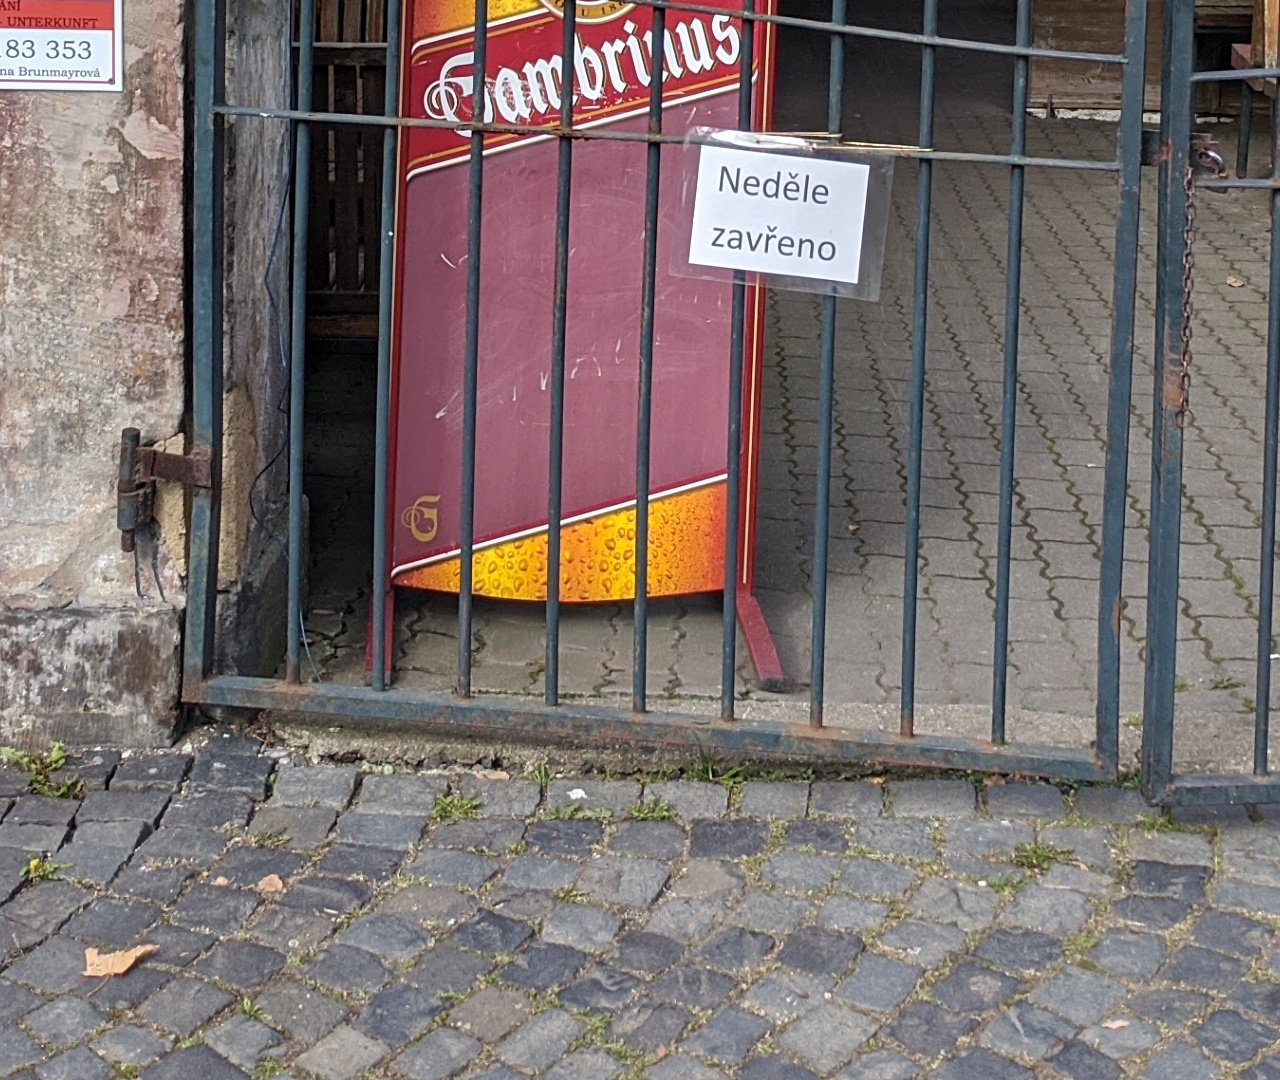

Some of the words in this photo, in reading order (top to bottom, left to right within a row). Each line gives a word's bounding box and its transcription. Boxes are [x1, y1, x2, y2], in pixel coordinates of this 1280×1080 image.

[8, 17, 99, 29] UNTERKUNFT
[46, 40, 92, 59] 353
[18, 67, 100, 79] Brunmayrová
[718, 165, 830, 205] Neděle
[711, 225, 837, 262] zavřeno
